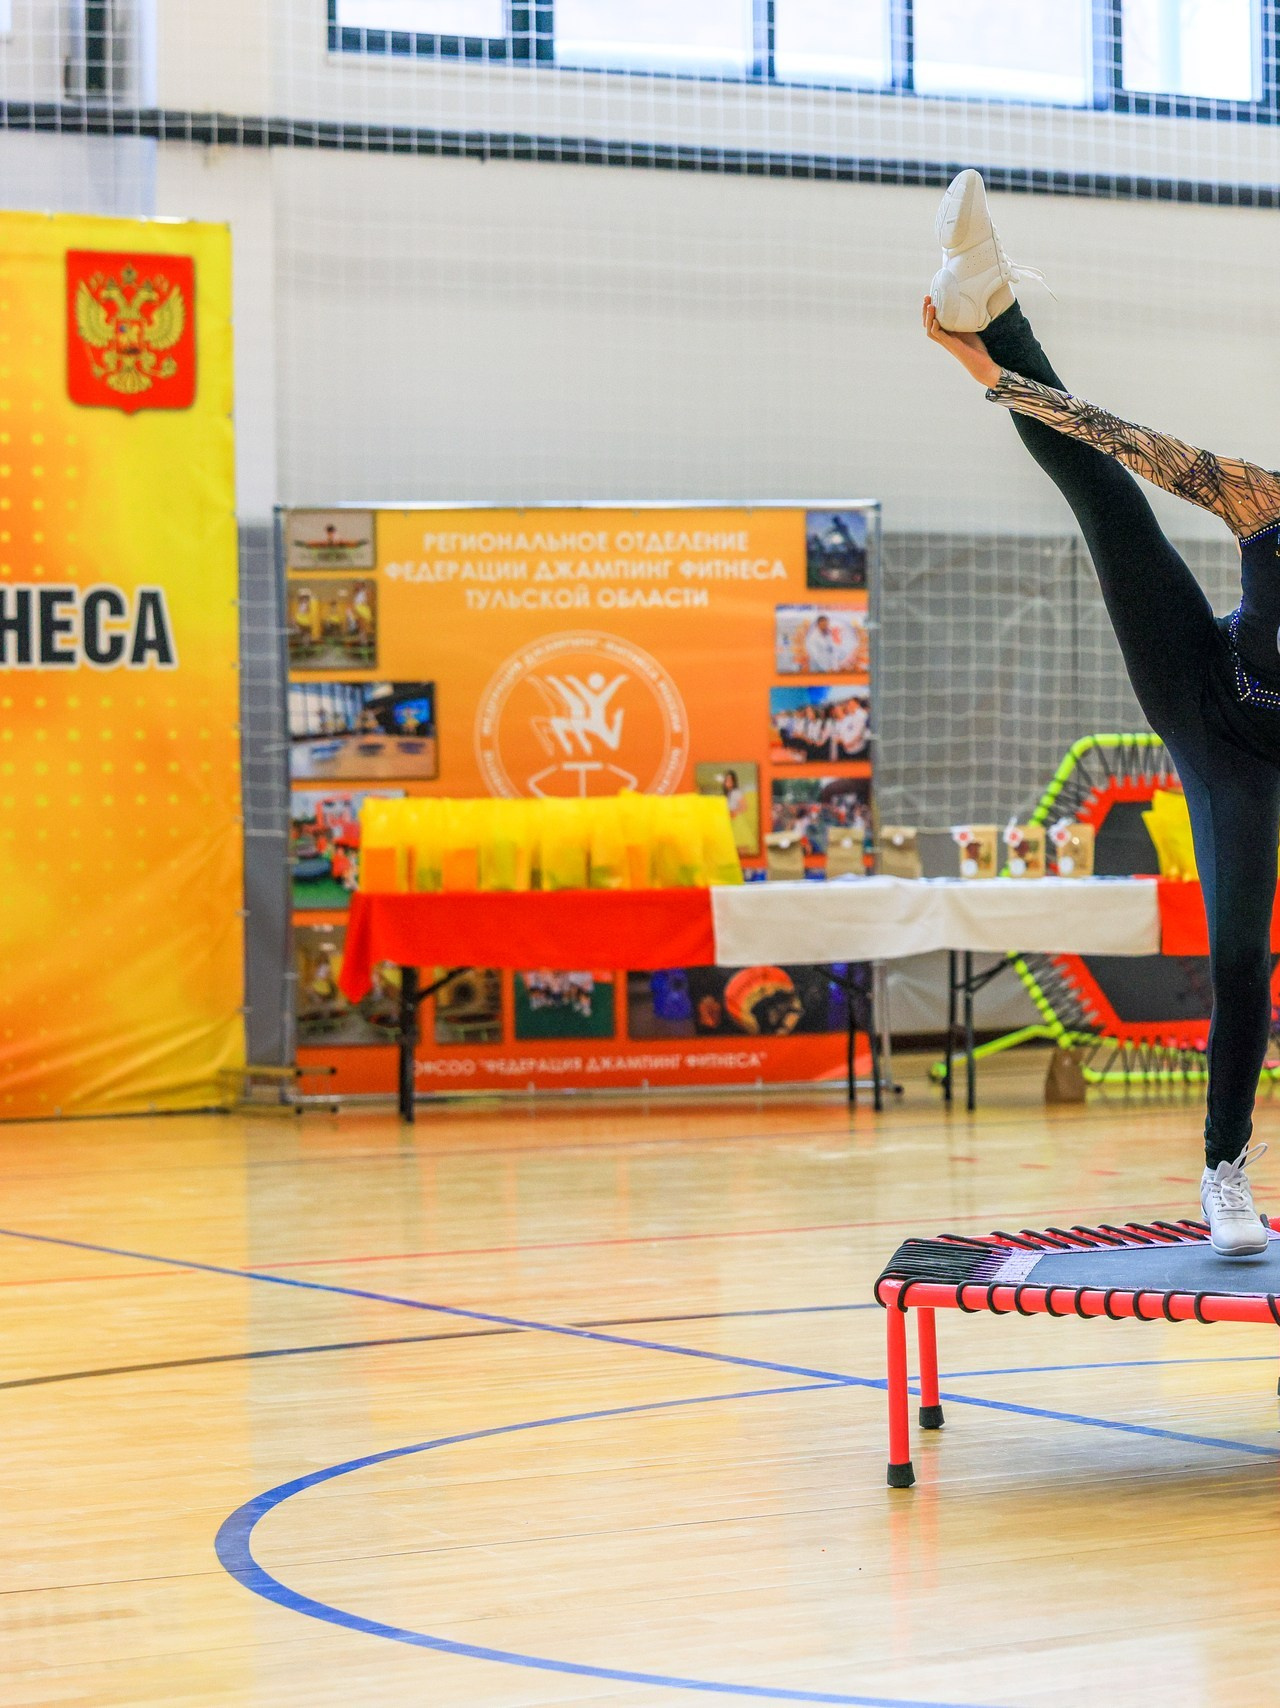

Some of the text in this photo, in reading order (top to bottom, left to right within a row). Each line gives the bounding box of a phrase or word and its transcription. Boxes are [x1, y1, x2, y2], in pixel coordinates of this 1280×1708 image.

[423, 530, 749, 555] РЕГИОНАЛЬНОЕ ОТДЕЛЕНИЕ
[384, 558, 788, 583] ФЕДЕРАЦИИ ДЖАМПИНГ ФИТНЕСА
[465, 584, 709, 610] ТУЛЬСКОЙ ОБЛАСТИ
